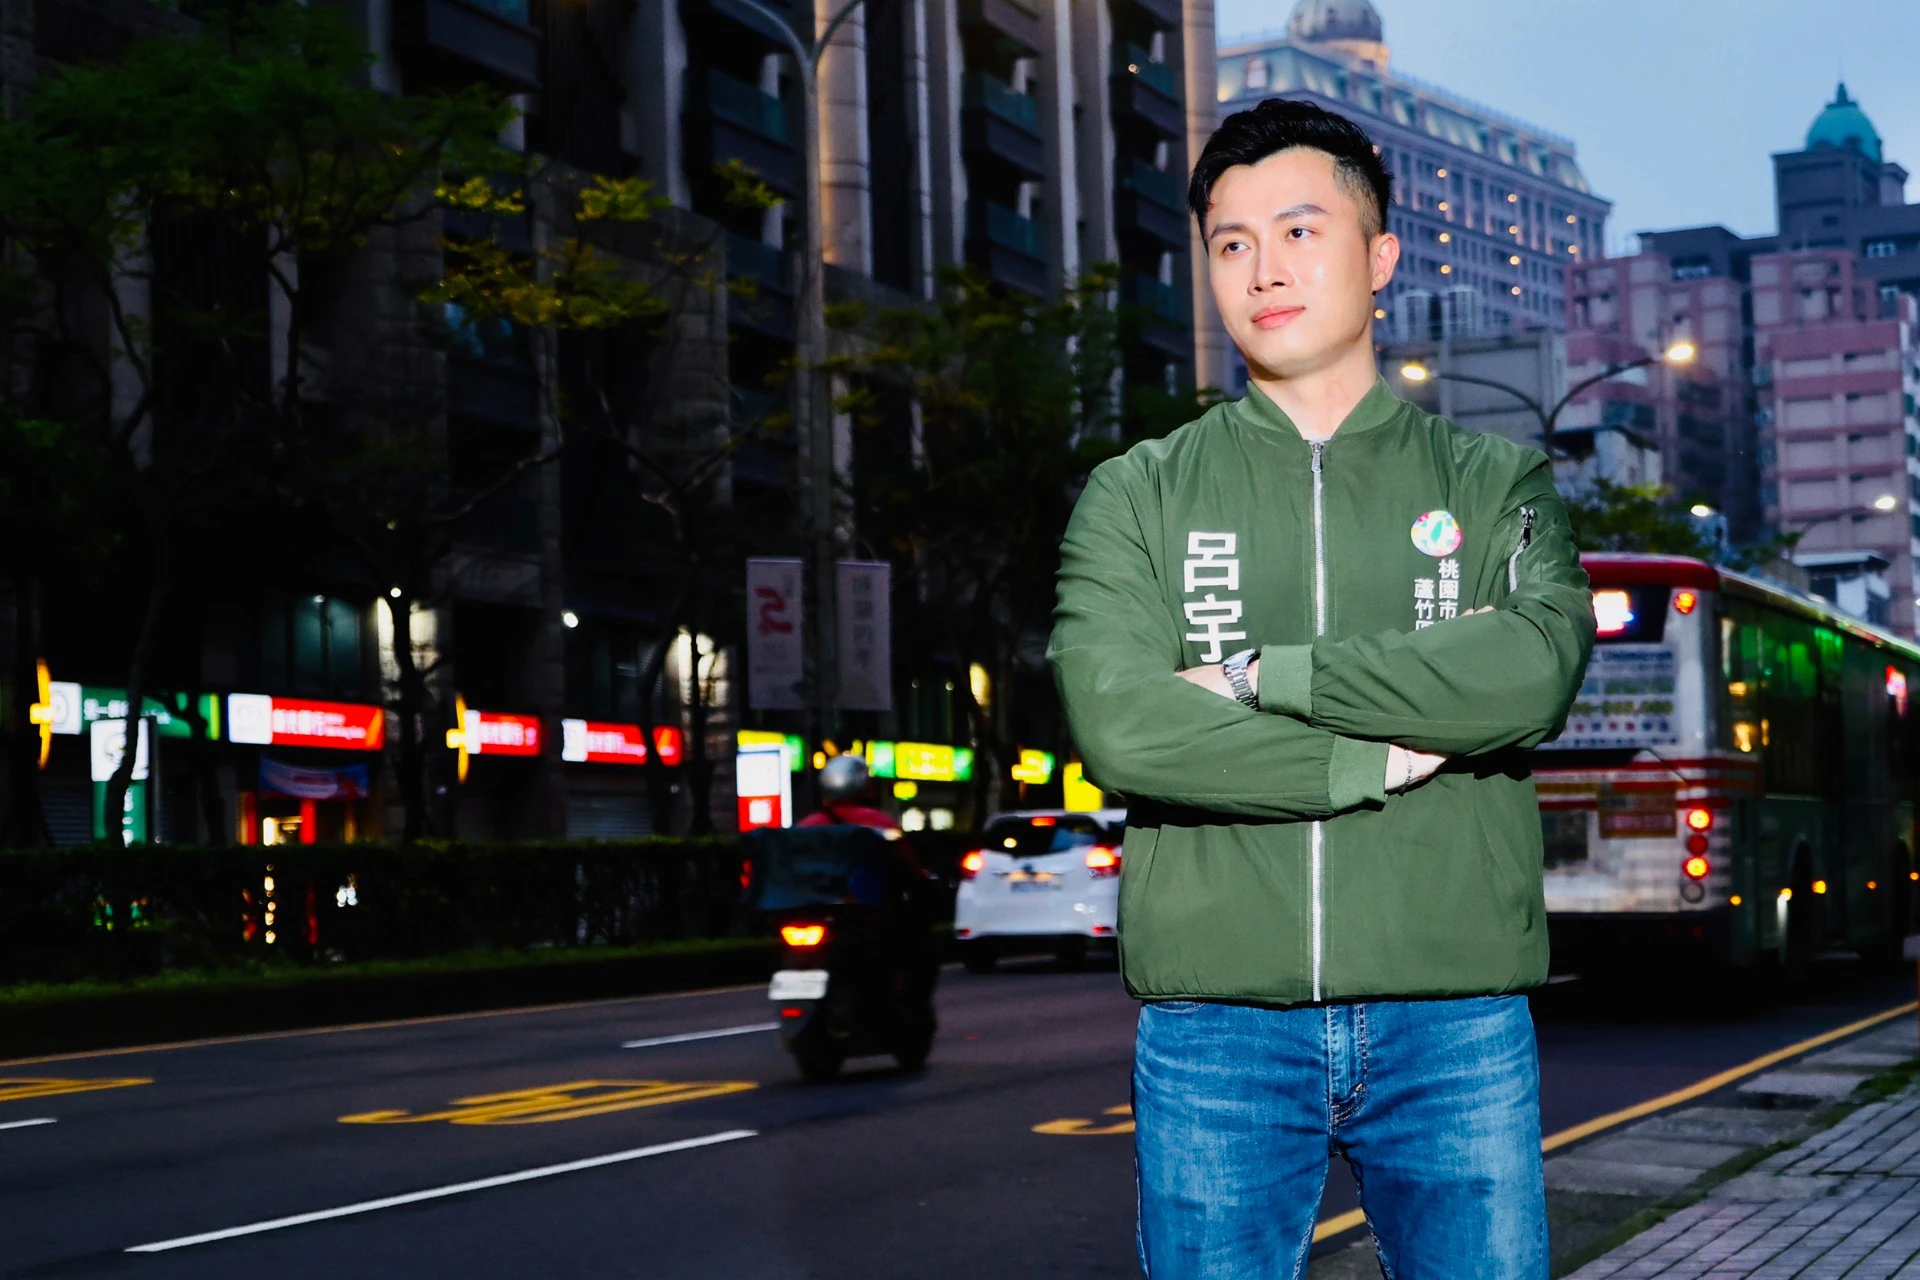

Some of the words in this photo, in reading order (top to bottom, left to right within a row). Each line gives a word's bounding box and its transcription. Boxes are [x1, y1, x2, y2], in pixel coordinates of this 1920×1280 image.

[1183, 531, 1246, 663] 呂宇
[1438, 558, 1460, 620] 桃園市
